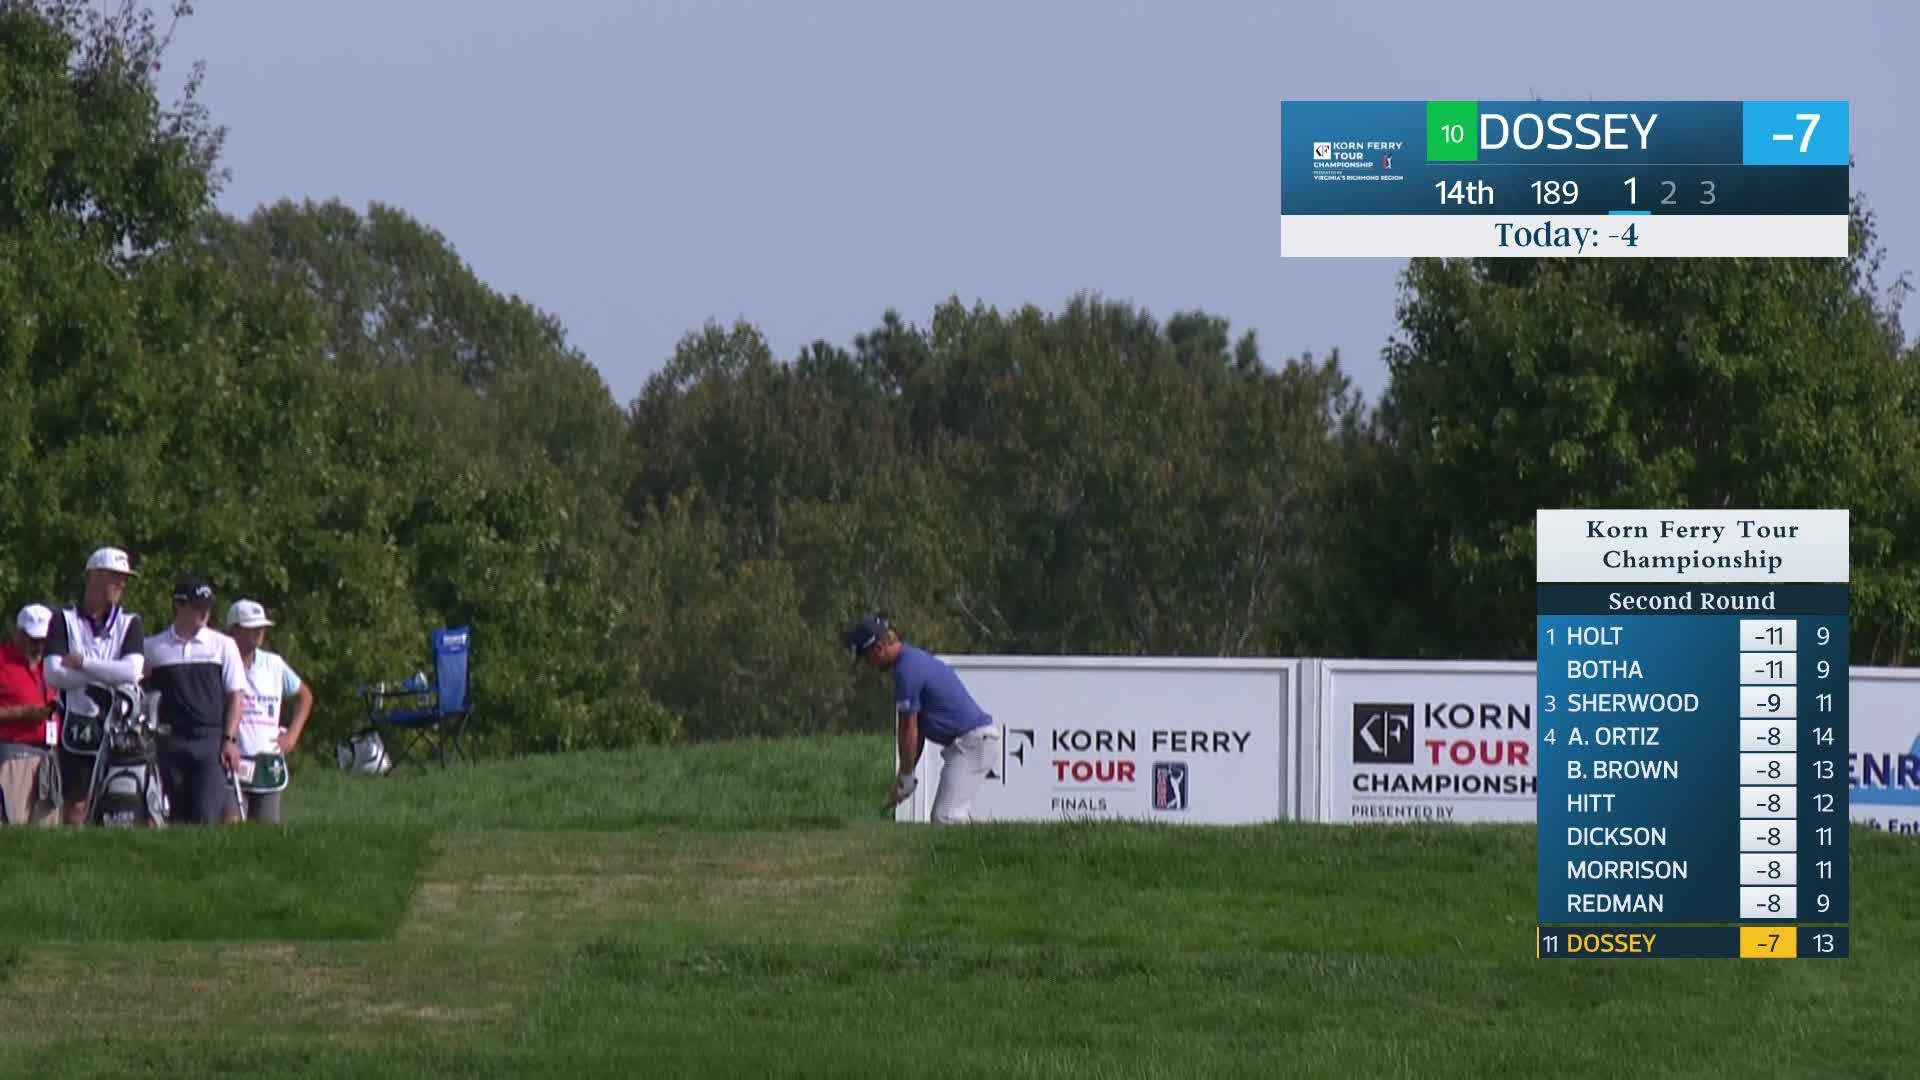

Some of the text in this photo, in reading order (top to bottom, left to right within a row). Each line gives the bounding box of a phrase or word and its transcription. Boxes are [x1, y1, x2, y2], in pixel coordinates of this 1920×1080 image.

[1424, 703, 1531, 729] KORN
[70, 725, 91, 742] 14
[1052, 729, 1251, 753] KORN FERRY
[1425, 739, 1530, 766] TOUR
[1052, 760, 1136, 782] TOUR
[1051, 797, 1107, 811] FINALS
[1351, 804, 1455, 819] PRESENTED BY
